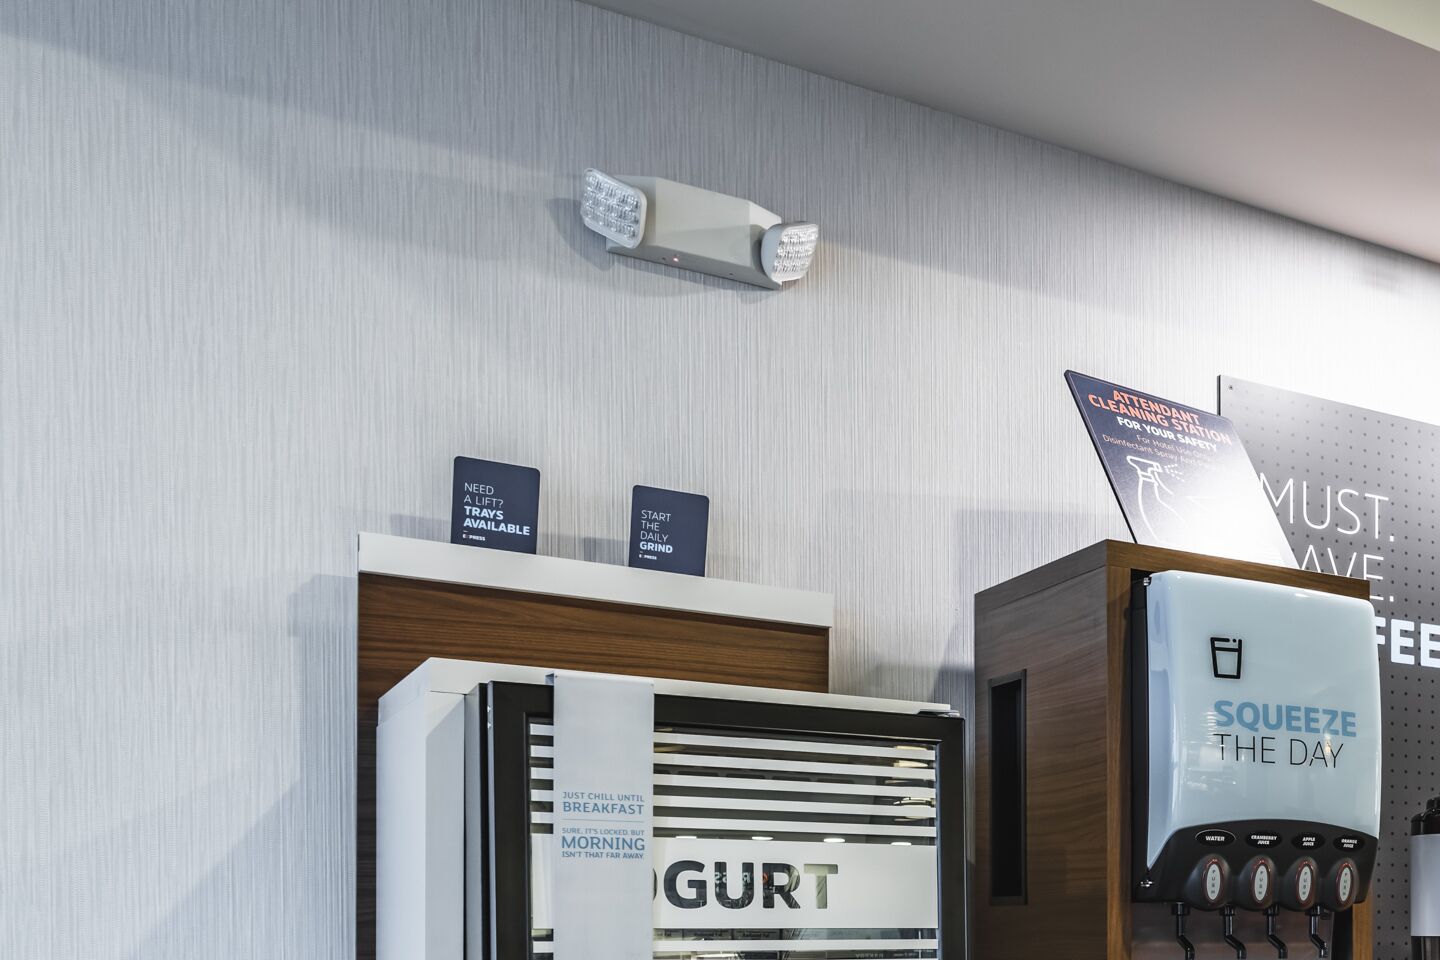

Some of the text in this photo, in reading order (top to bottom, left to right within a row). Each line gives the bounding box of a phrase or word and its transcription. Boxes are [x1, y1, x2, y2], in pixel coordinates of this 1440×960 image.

[1113, 390, 1199, 425] ATTENDANT
[1088, 394, 1232, 445] CLEANING STATION
[1117, 416, 1217, 452] FOR YOUR SAFETY
[1103, 434, 1153, 454] Disinfectant
[464, 482, 494, 495] NEED
[464, 495, 504, 509] A LIFT?
[1259, 472, 1394, 542] MUST.
[464, 506, 504, 520] TRAYS
[641, 509, 672, 522] START
[463, 518, 531, 536] AVAILABLE
[641, 520, 660, 532] THE
[462, 533, 486, 541] EPRESS
[640, 530, 669, 543] DAILY
[639, 541, 673, 554] GRIND
[1214, 700, 1357, 738] SQUEEZE
[1213, 733, 1344, 768] THE DAY
[562, 791, 645, 802] JUST CHILL UNTIL
[563, 801, 644, 815] BREAKFAST
[562, 836, 645, 851] MORNING
[584, 851, 603, 859] THAT
[652, 860, 839, 910] GURT
